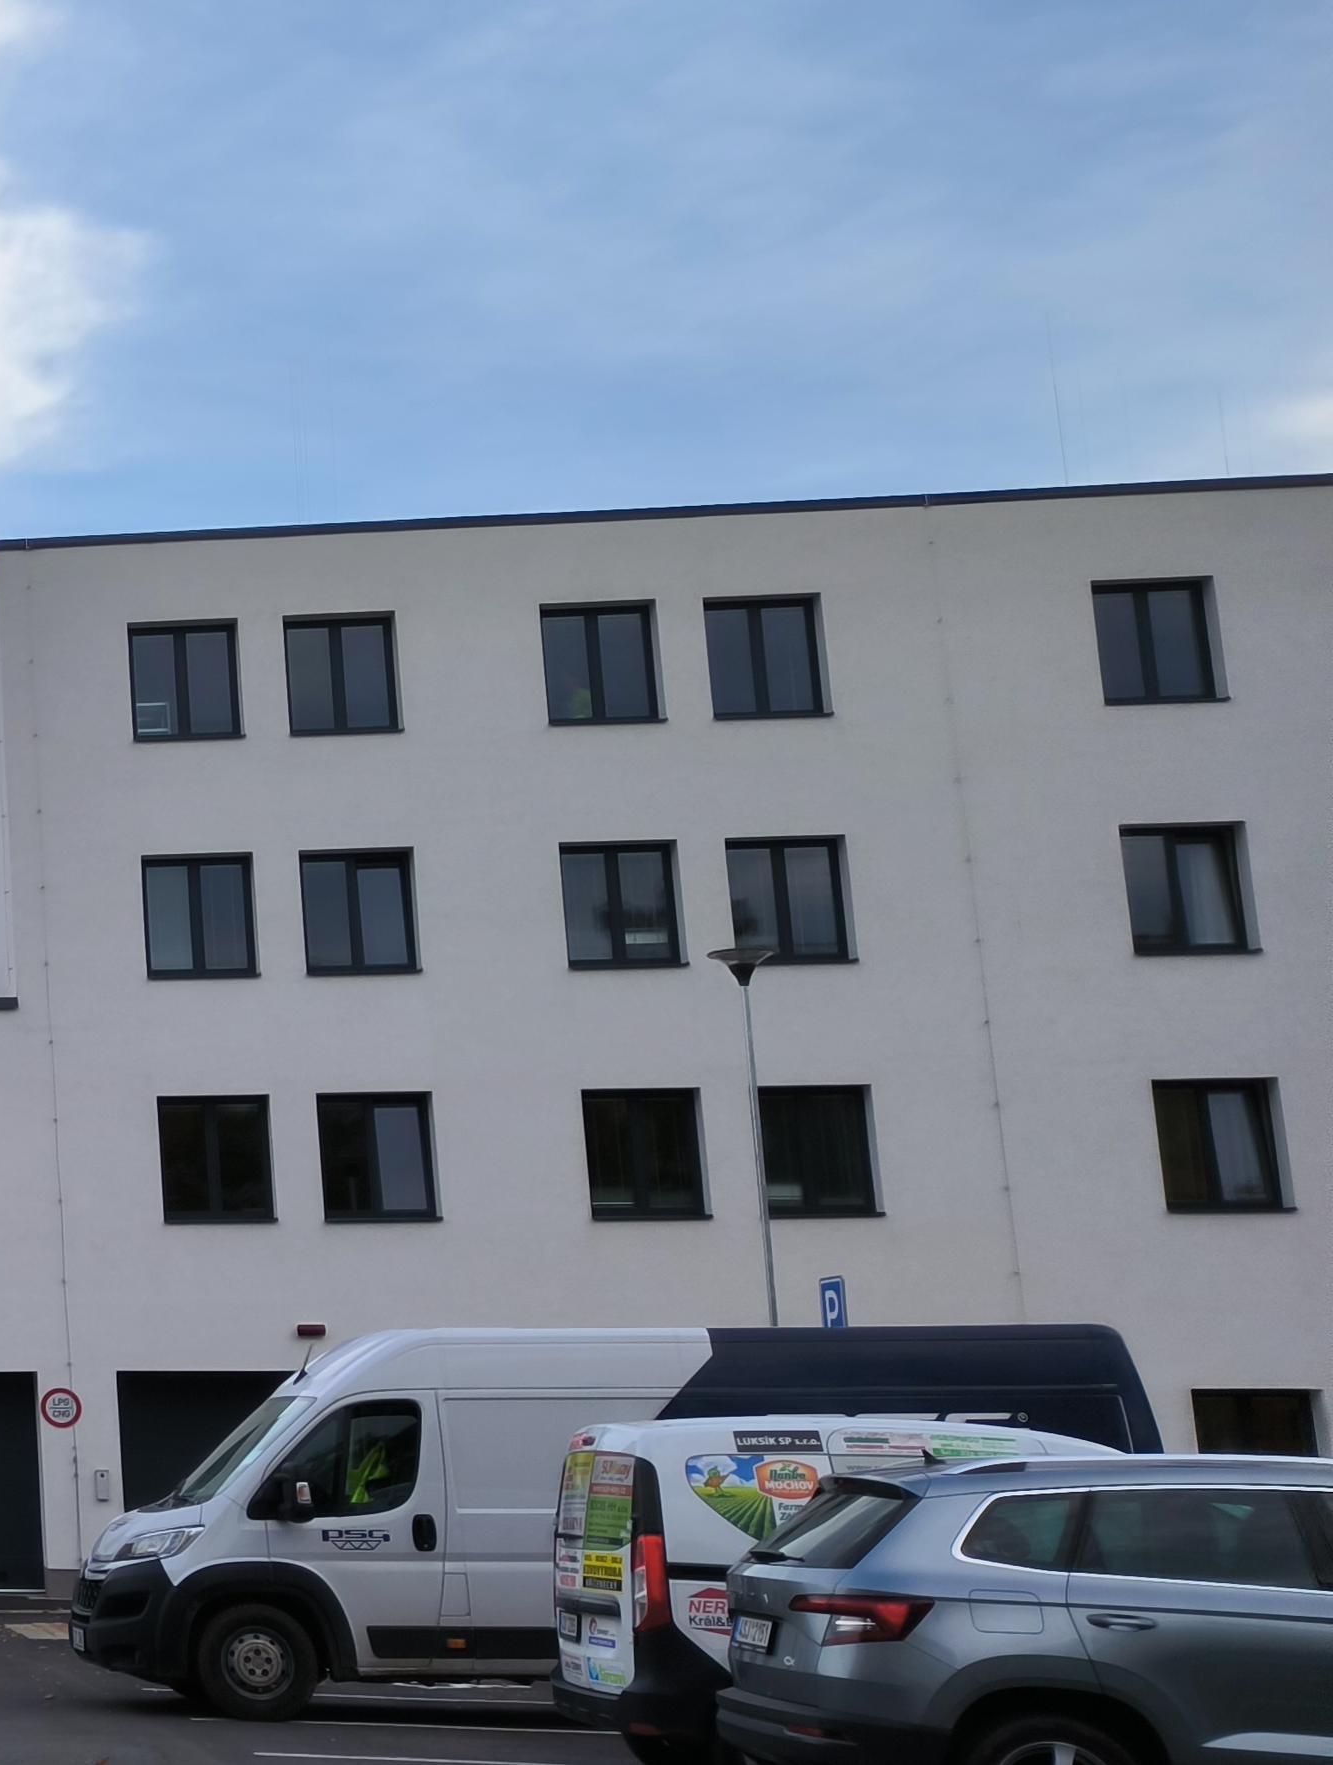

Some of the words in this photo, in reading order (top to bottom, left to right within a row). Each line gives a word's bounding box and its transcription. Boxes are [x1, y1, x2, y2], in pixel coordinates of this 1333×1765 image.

[824, 1290, 839, 1327] P
[53, 1398, 70, 1406] LPG
[53, 1410, 71, 1418] CNG
[778, 1436, 792, 1445] SP
[765, 1480, 814, 1490] MOCHOV
